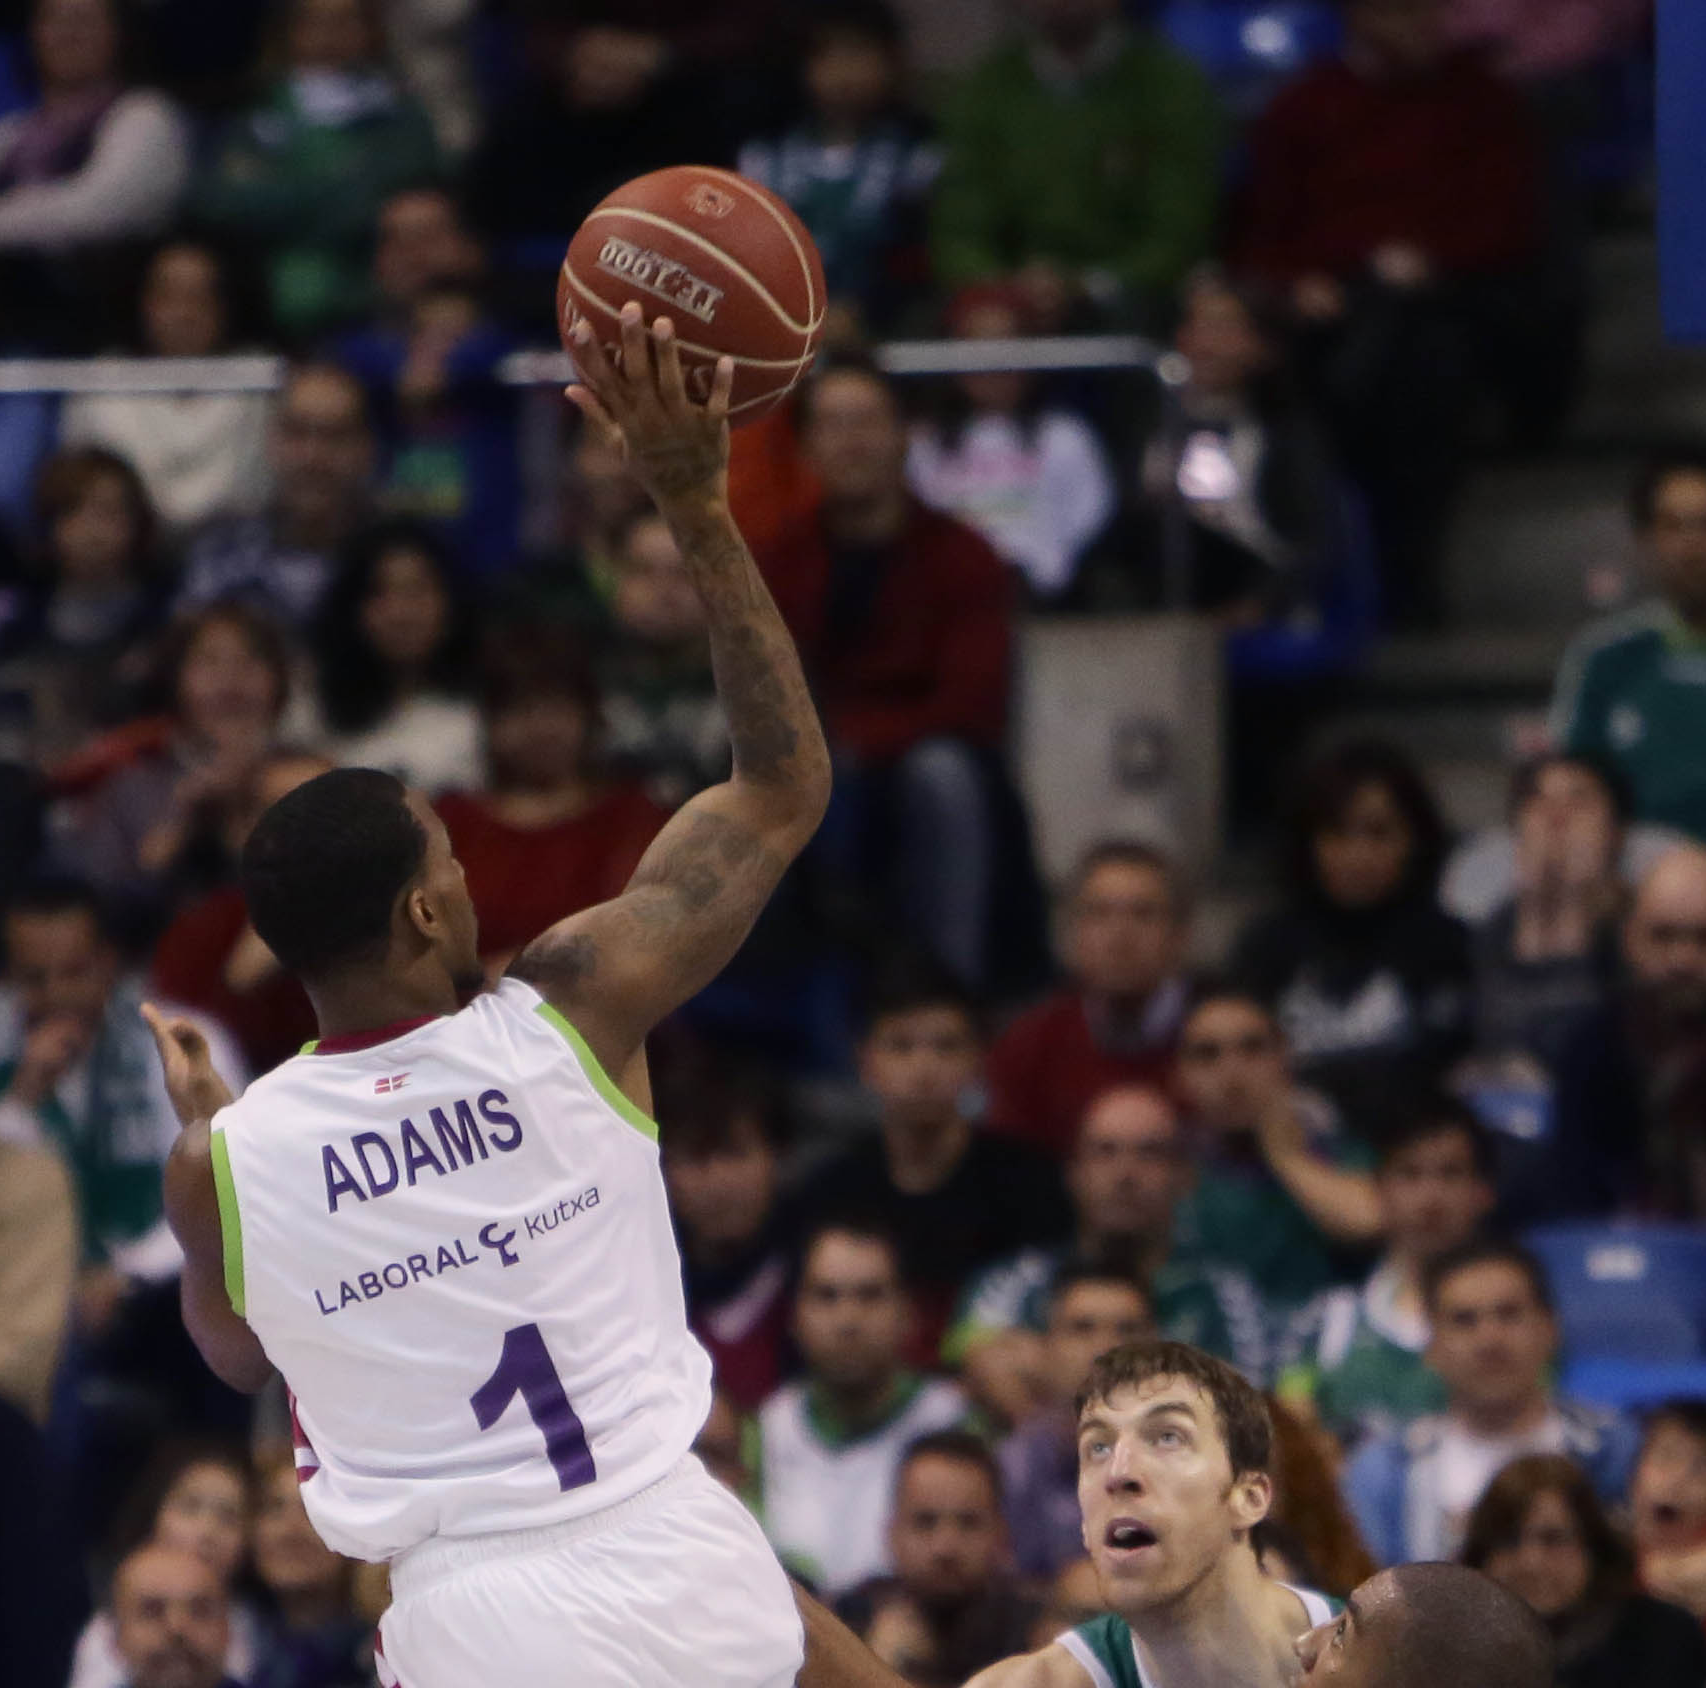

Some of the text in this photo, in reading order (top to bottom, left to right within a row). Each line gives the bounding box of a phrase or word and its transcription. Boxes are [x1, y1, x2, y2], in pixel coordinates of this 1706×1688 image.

[320, 1088, 523, 1213] ADAMS
[314, 1186, 601, 1316] LABORAL kutxa
[468, 1322, 597, 1492] 1
